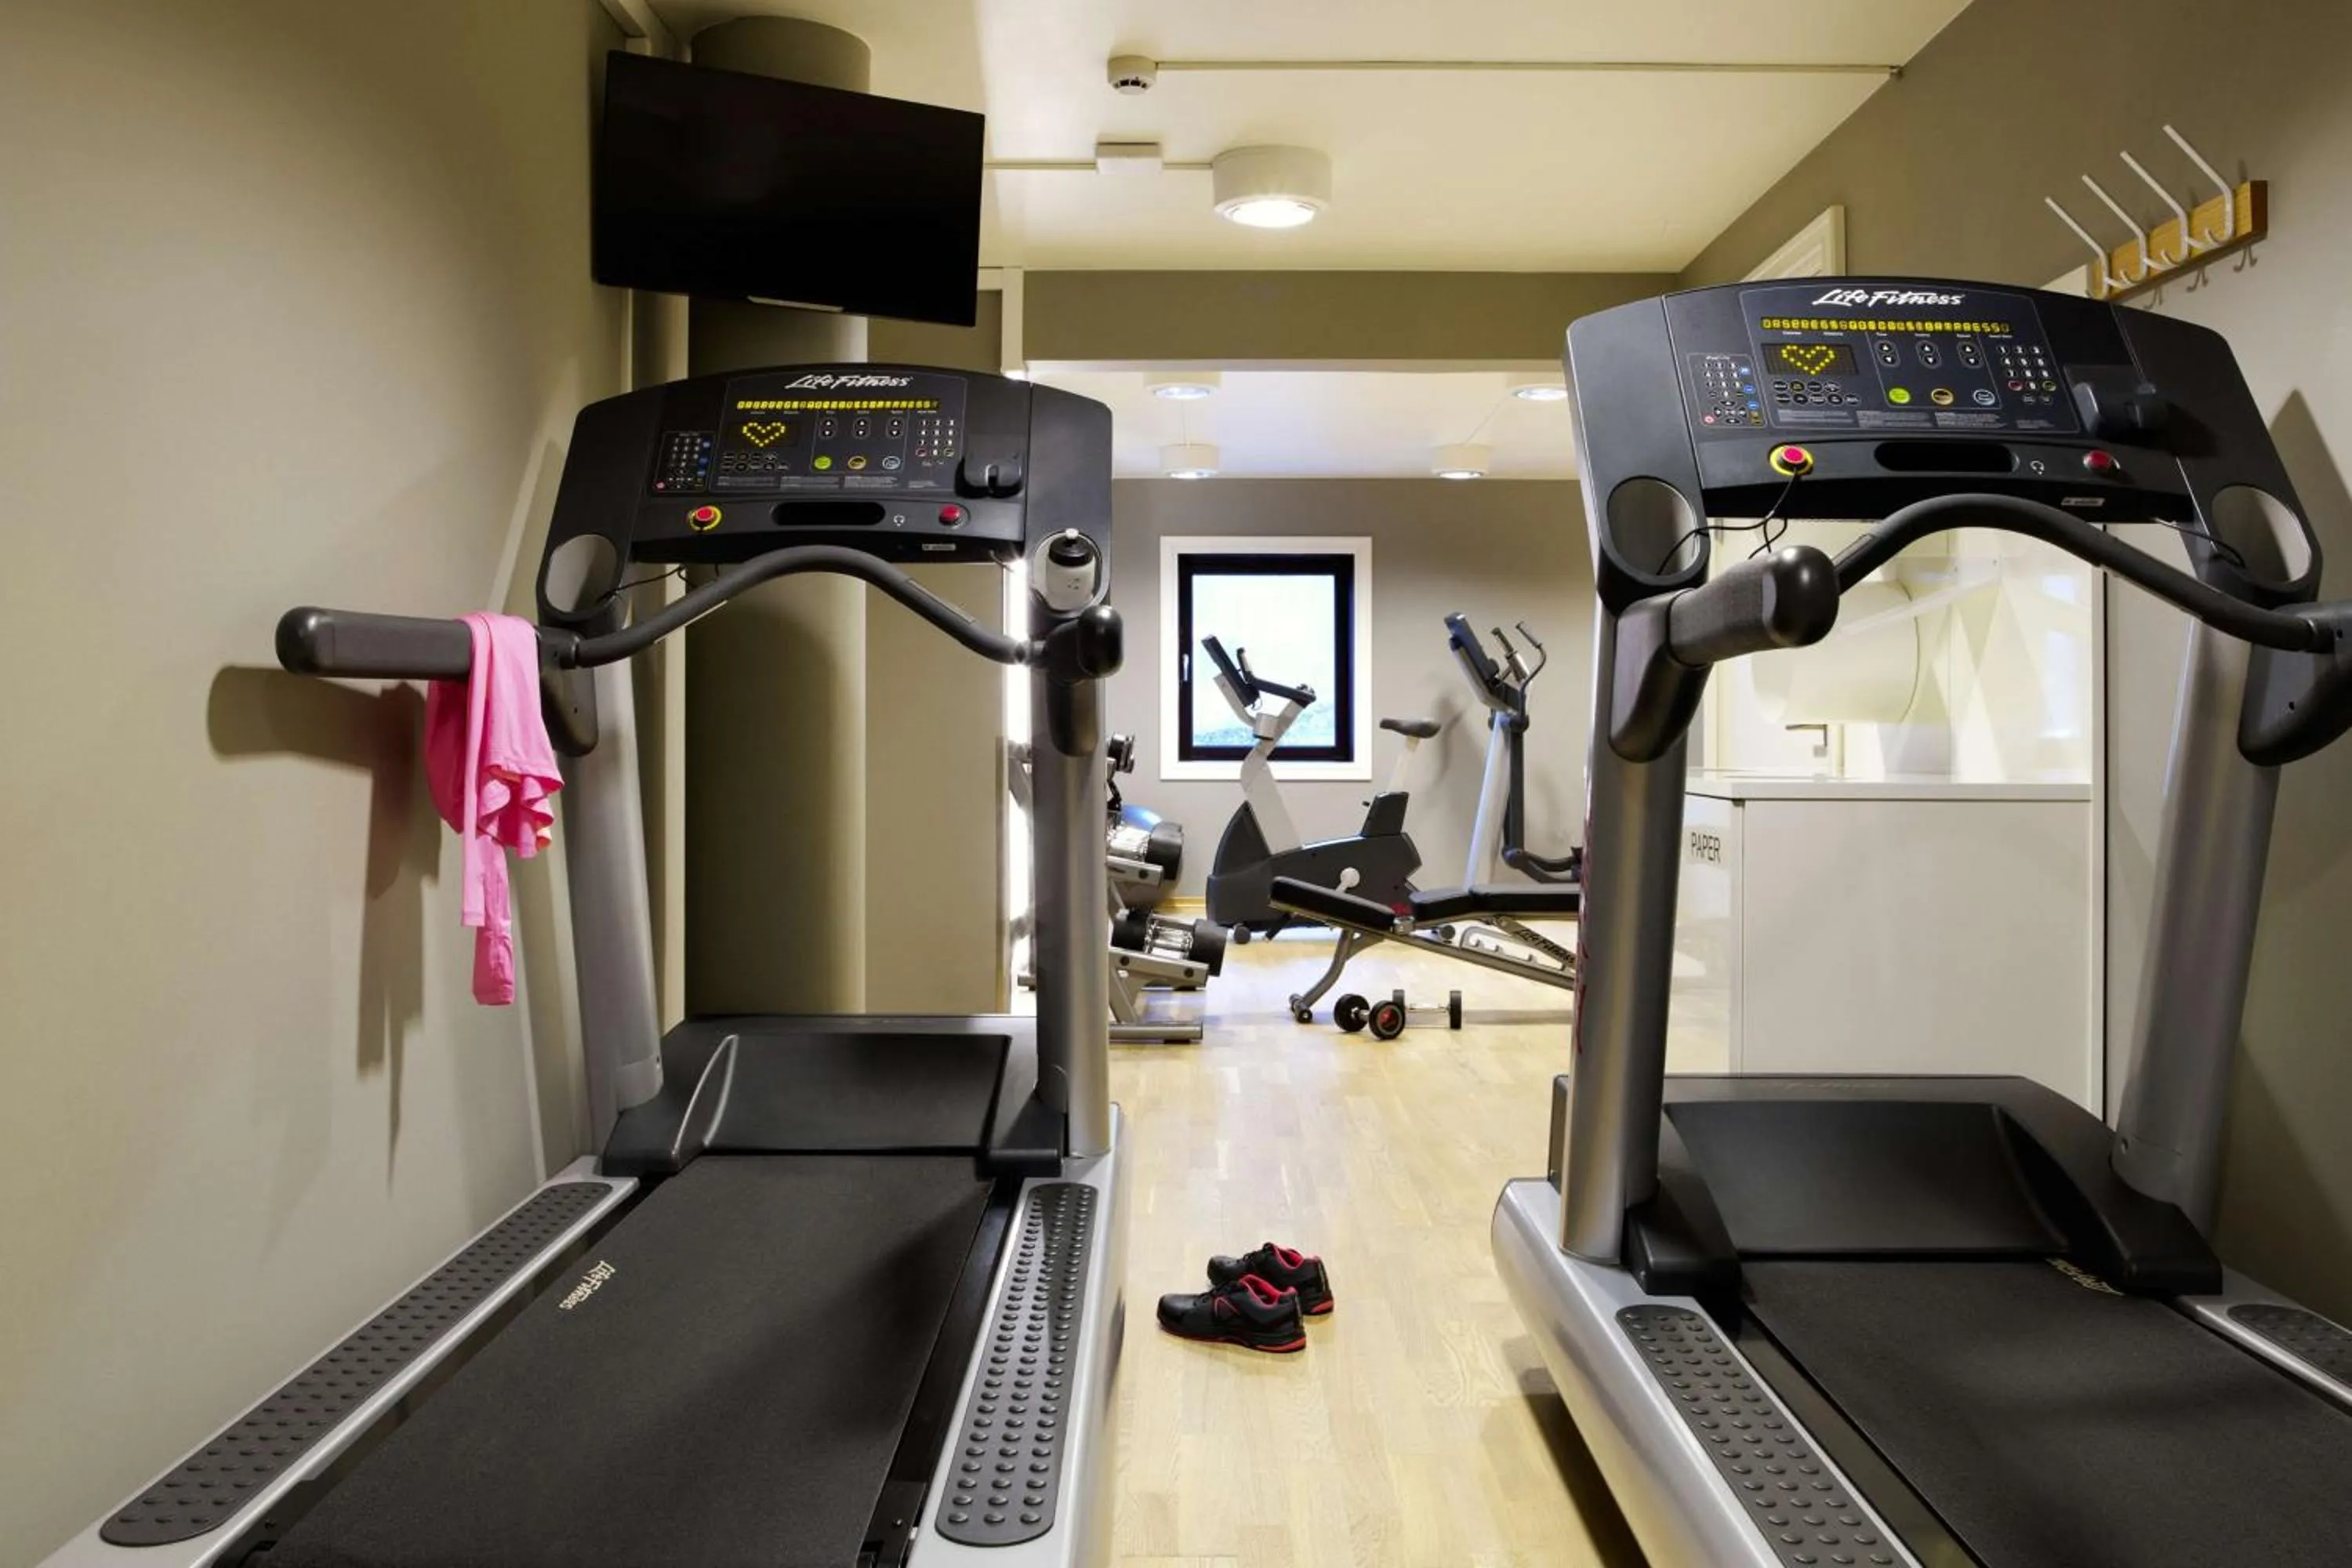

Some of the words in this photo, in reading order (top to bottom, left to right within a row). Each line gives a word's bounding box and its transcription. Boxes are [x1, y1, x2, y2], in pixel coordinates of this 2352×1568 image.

[1811, 288, 1869, 307] Life
[1867, 290, 1962, 307] Fitness
[784, 374, 834, 390] Life
[830, 375, 911, 390] Fitness
[1691, 832, 1721, 863] PAPER
